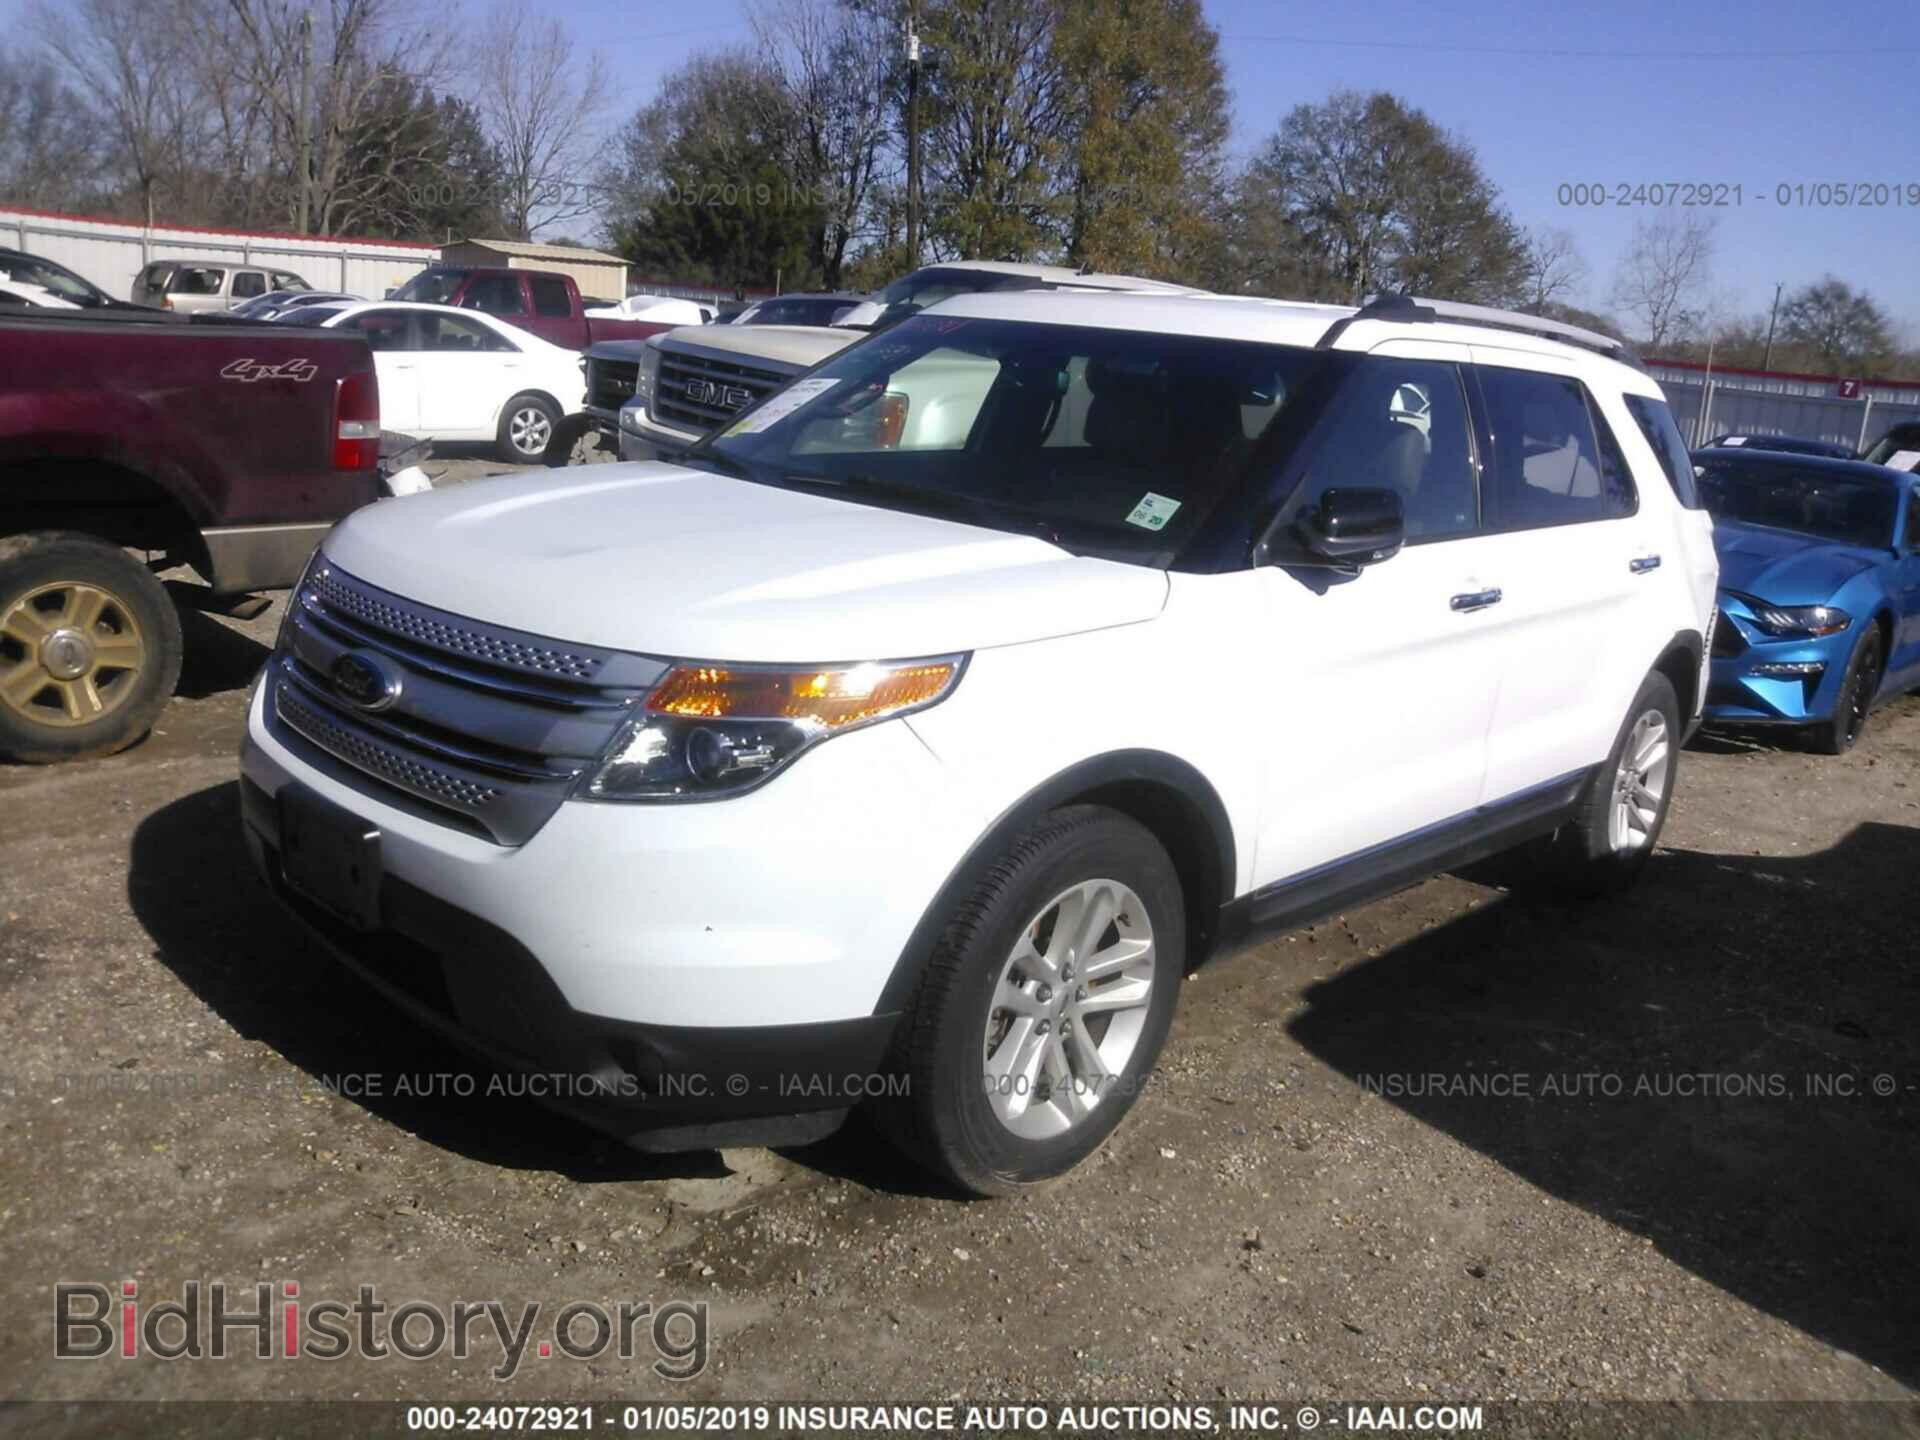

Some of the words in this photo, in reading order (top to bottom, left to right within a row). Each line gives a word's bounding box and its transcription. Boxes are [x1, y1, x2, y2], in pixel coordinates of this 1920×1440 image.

[220, 359, 319, 382] 4x4
[687, 378, 751, 413] GMC
[1844, 381, 1855, 395] 7
